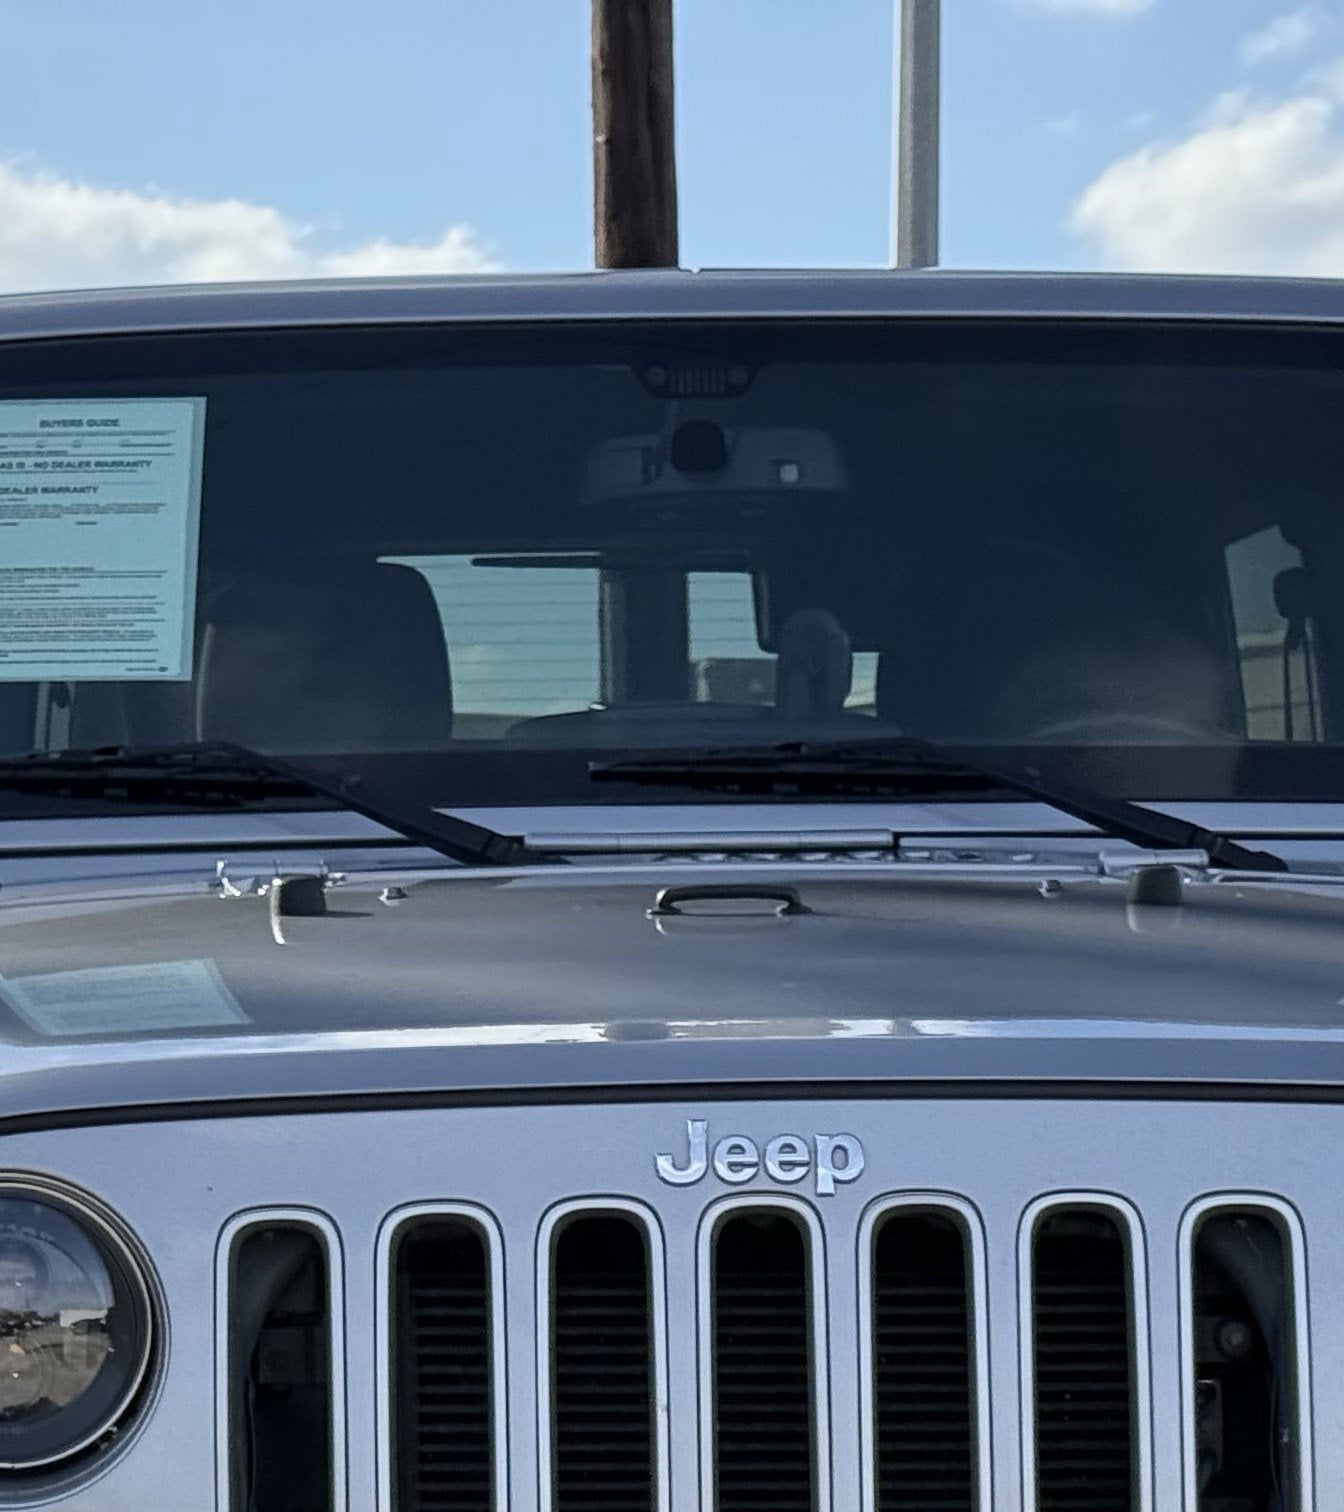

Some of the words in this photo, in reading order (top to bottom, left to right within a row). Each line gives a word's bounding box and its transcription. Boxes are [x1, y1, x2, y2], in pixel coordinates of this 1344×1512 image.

[39, 419, 84, 428] BUYERS
[86, 418, 119, 427] GUIDE
[51, 460, 92, 469] DEALER
[93, 459, 153, 468] WARRANTY
[40, 485, 99, 494] WARRANTY
[655, 1118, 865, 1198] Jeep
